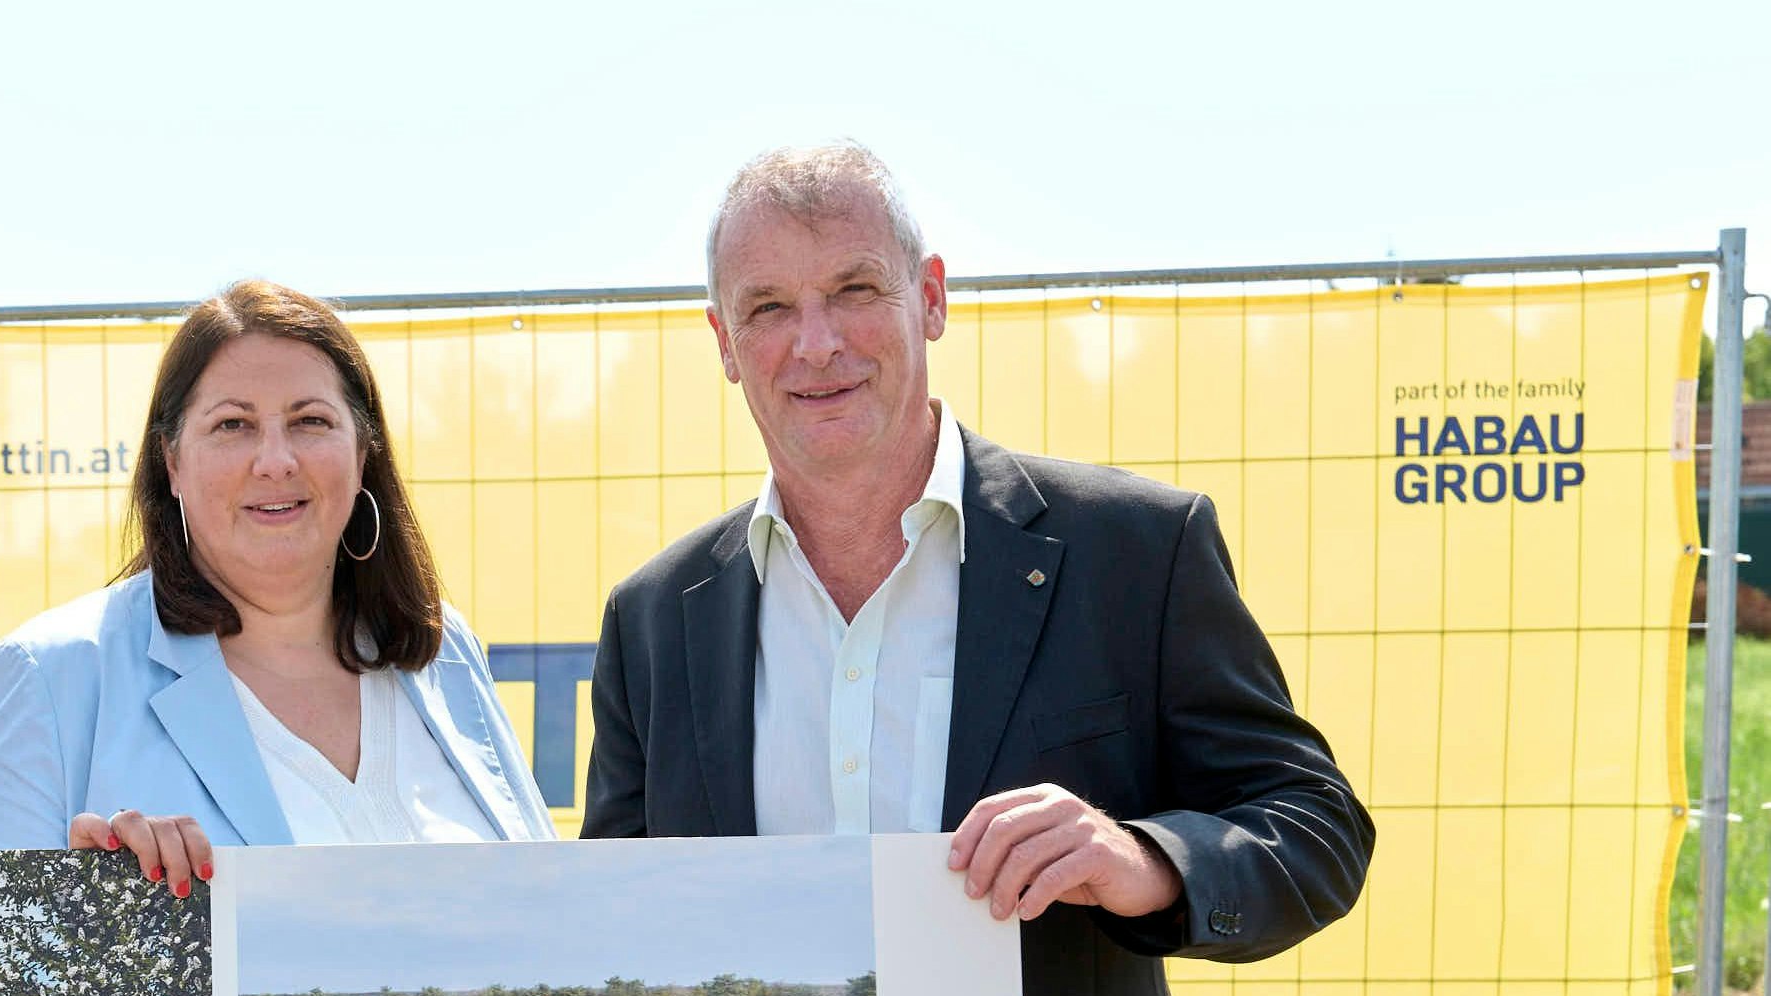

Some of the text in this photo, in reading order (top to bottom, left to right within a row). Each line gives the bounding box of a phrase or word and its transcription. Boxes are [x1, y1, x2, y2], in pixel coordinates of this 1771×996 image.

[1394, 378, 1586, 404] part of the family
[1395, 413, 1585, 457] HABAU
[1394, 462, 1586, 504] GROUP
